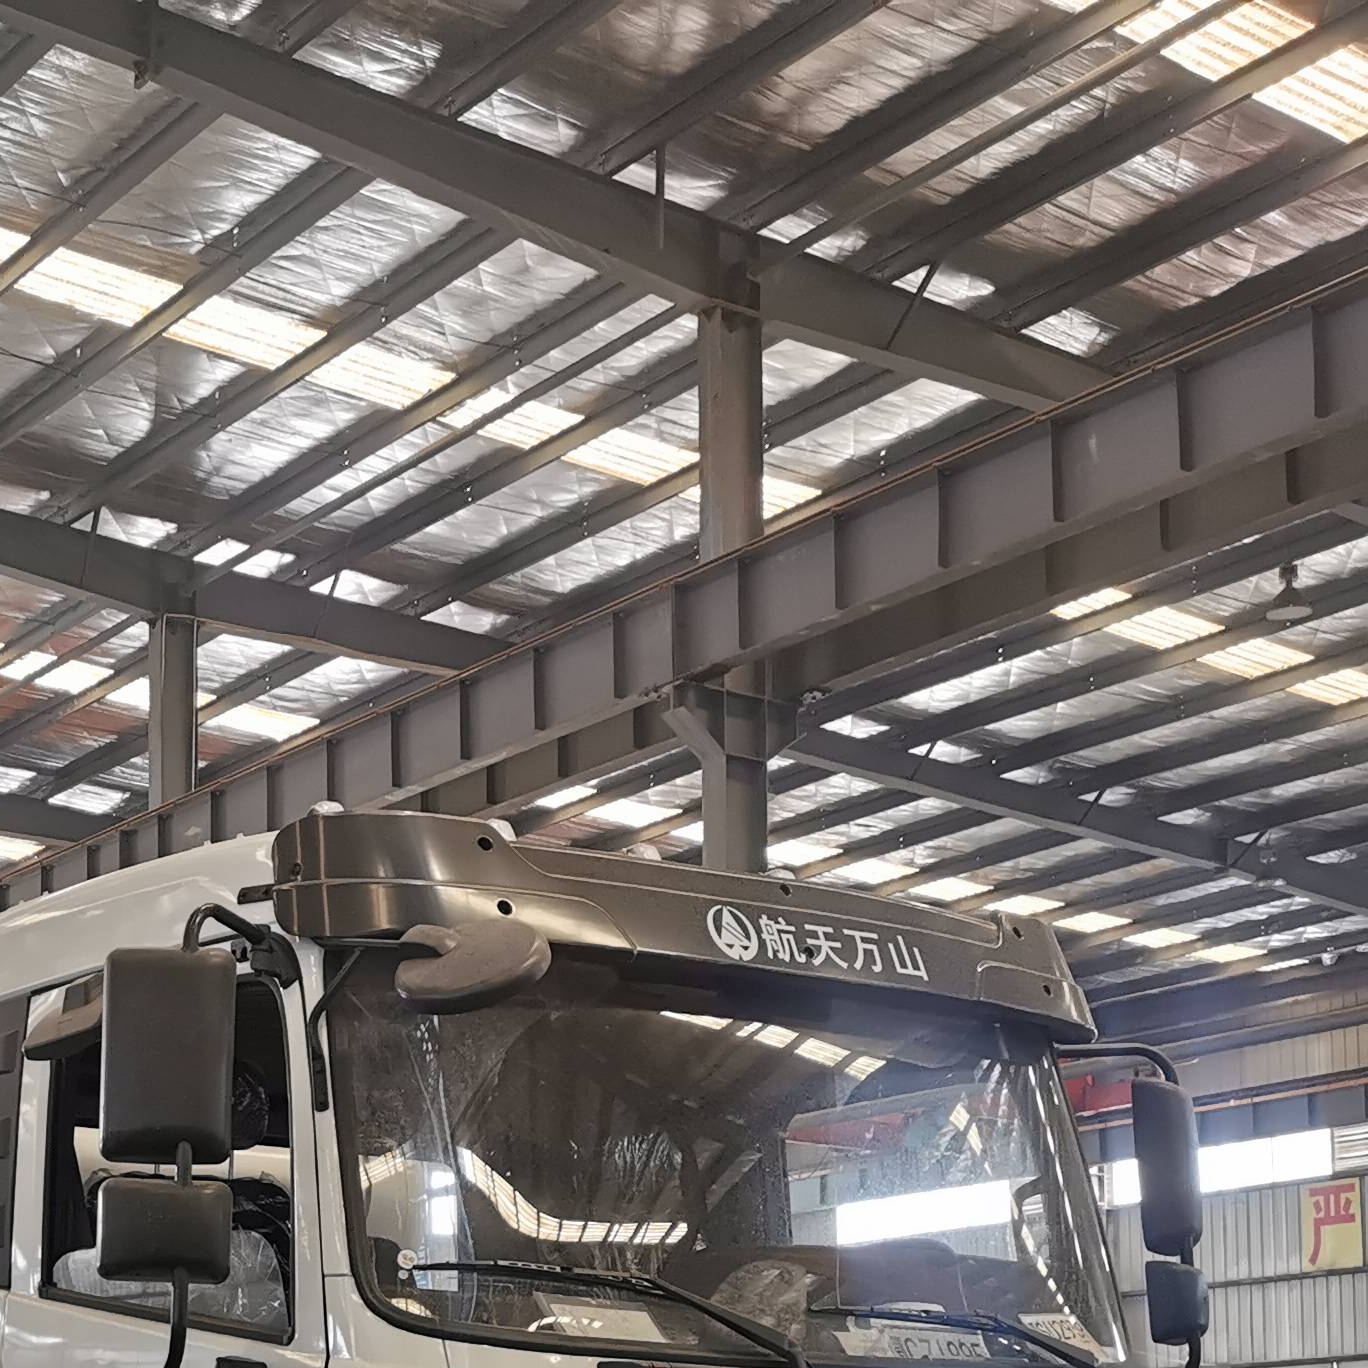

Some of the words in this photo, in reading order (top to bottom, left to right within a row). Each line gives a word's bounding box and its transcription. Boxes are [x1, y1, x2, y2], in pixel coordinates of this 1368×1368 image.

[758, 914, 929, 981] 航天万山
[1308, 1183, 1356, 1266] 严
